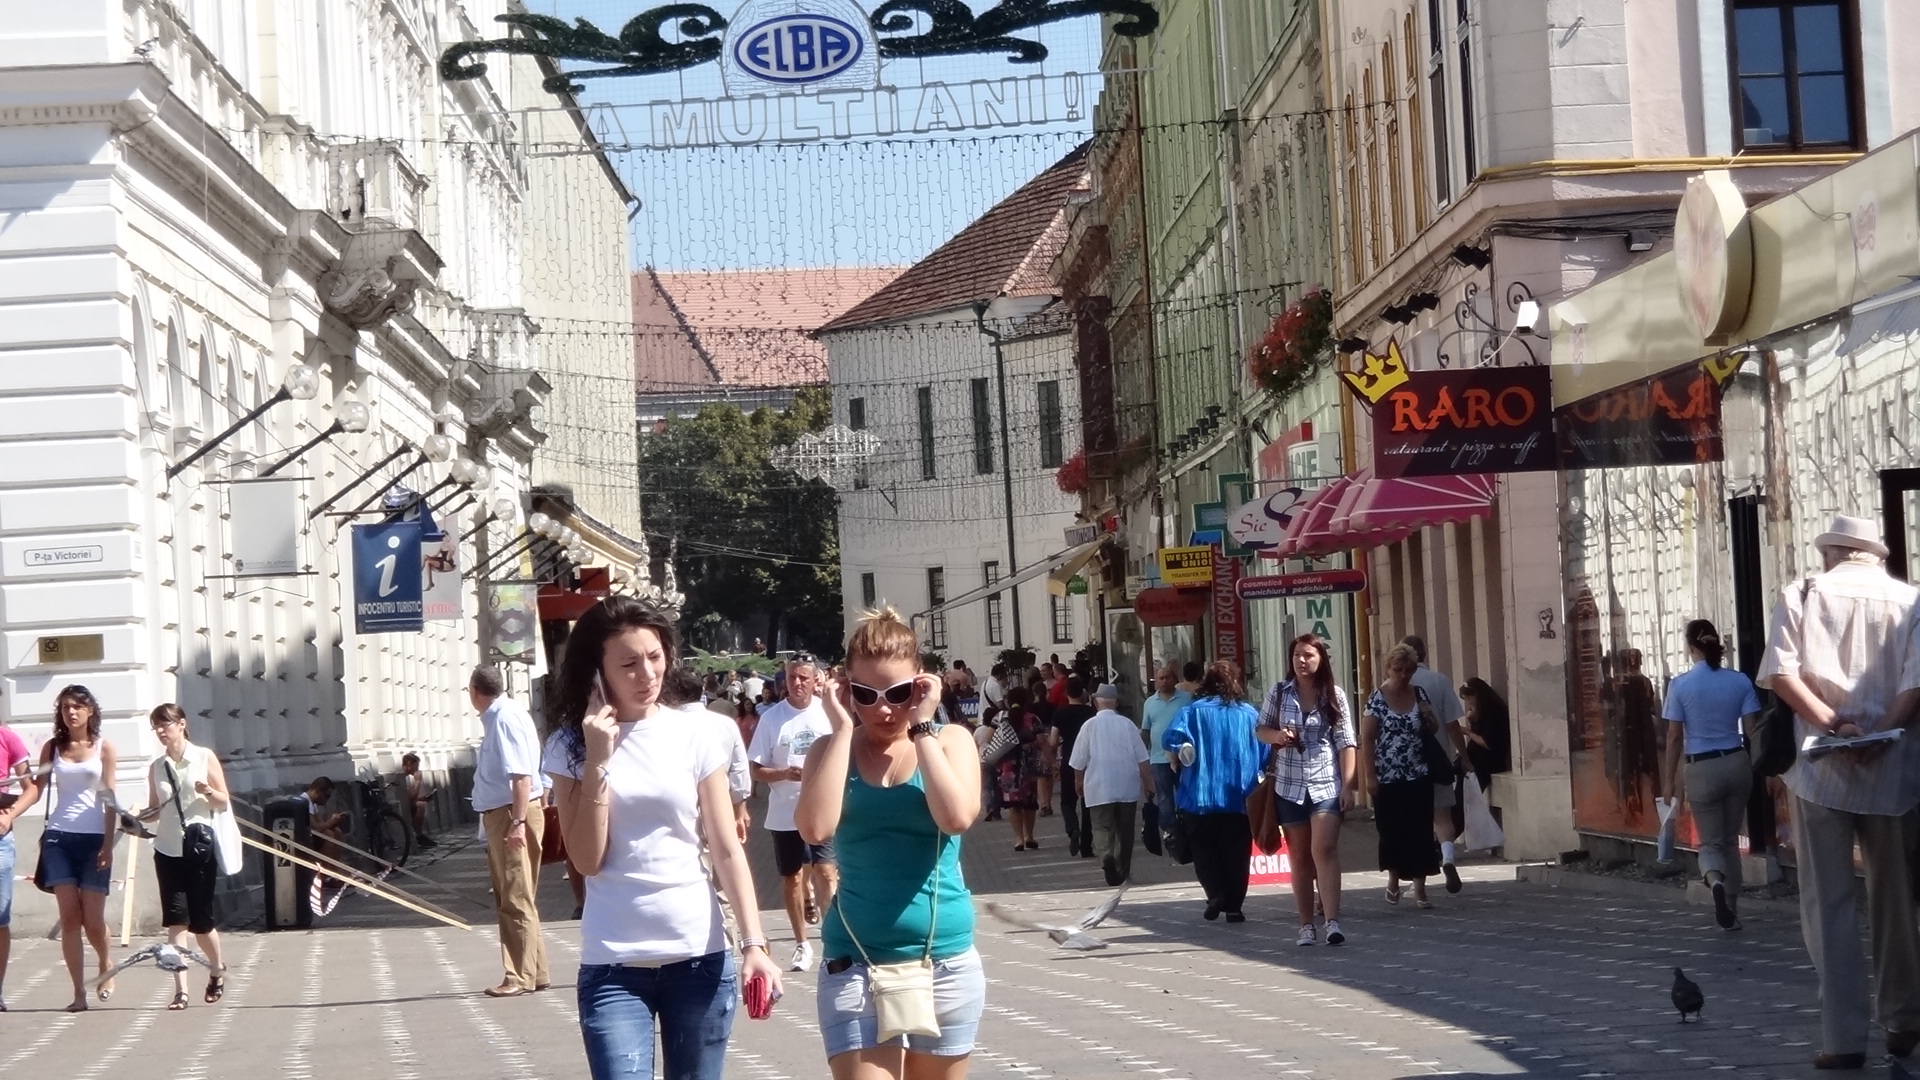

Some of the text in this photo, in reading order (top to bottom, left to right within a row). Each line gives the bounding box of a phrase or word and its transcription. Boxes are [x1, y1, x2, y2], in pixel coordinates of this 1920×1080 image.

[747, 25, 850, 72] ELBA
[524, 102, 631, 157] LA
[650, 86, 894, 149] MULTI
[1390, 386, 1535, 431] RARO
[1384, 440, 1449, 455] restaurant
[1451, 440, 1494, 468] pizza
[54, 550, 93, 560] Victoriei
[358, 601, 422, 615] INFOCENTRU TURISTIC
